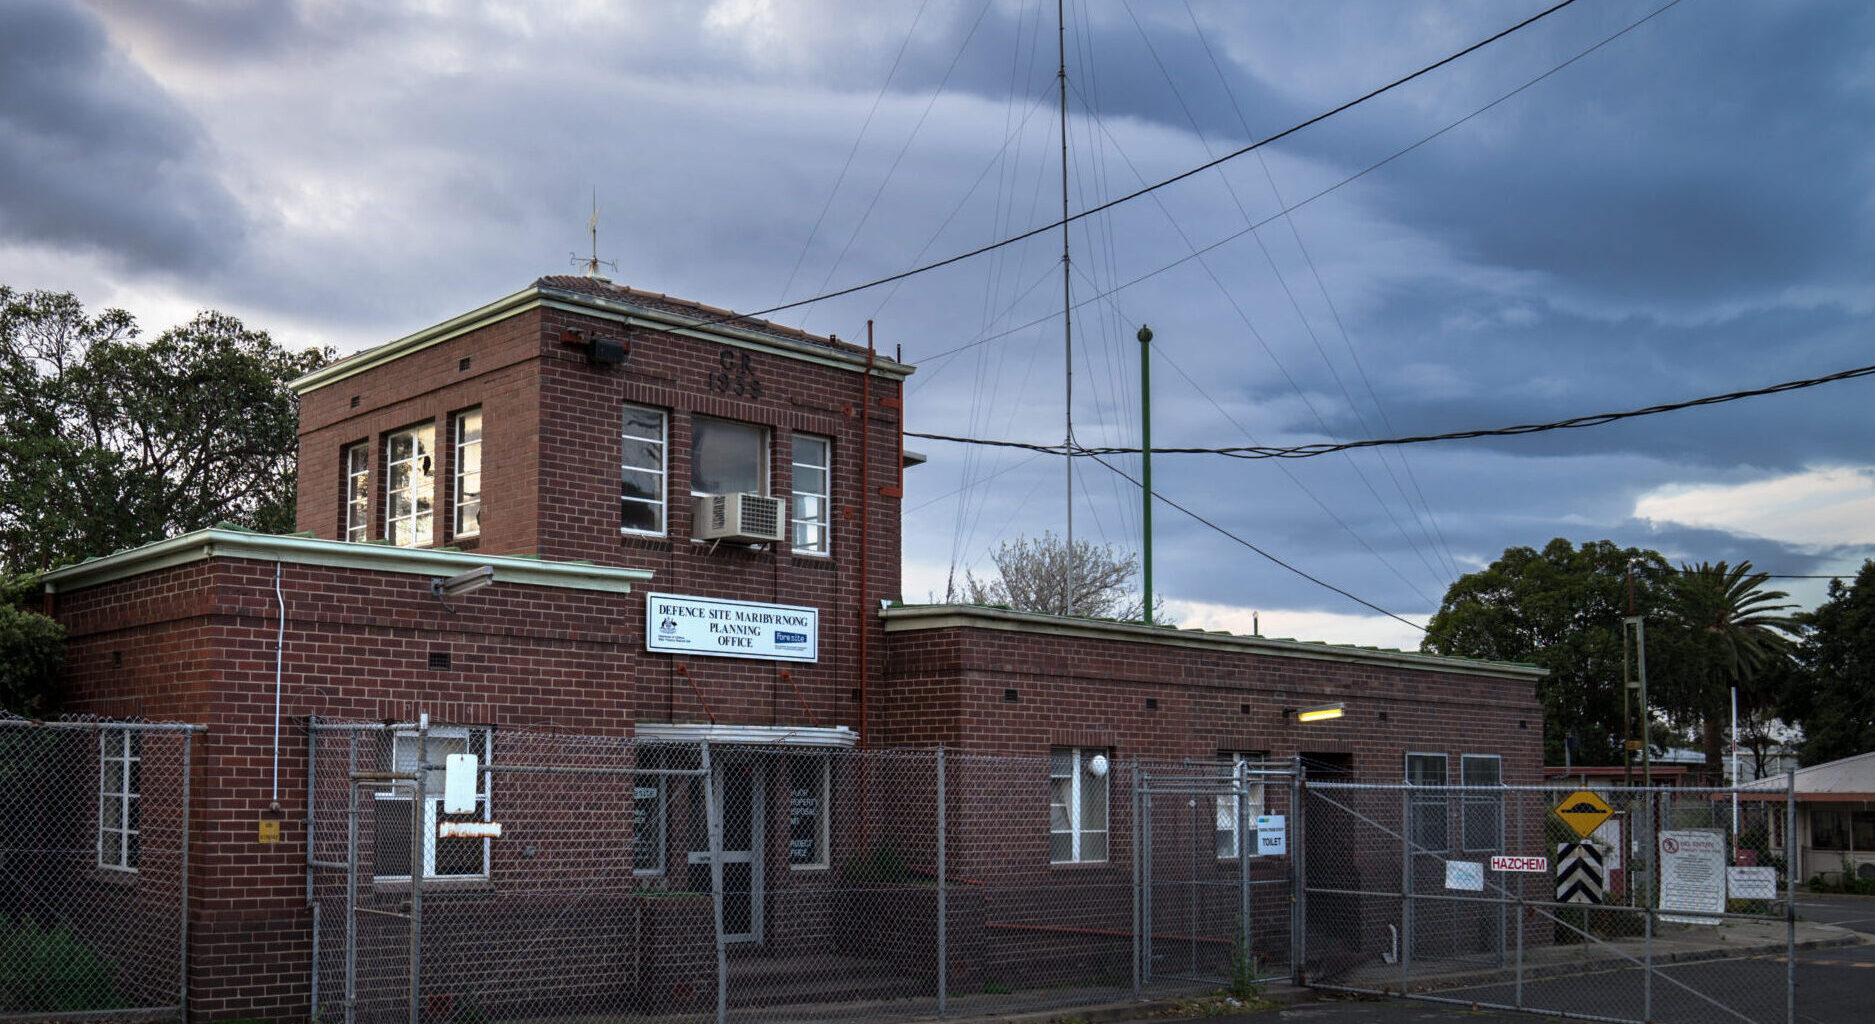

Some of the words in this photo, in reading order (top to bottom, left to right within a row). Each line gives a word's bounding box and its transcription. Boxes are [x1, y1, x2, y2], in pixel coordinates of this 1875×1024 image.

[659, 604, 705, 619] DEFENCE
[708, 609, 732, 621] SITE
[735, 611, 808, 627] MARIBYRNONG
[710, 622, 761, 637] PLANNING
[718, 636, 753, 648] OFFICE
[1262, 837, 1281, 847] TOILET
[1492, 858, 1545, 870] HAZCHEM
